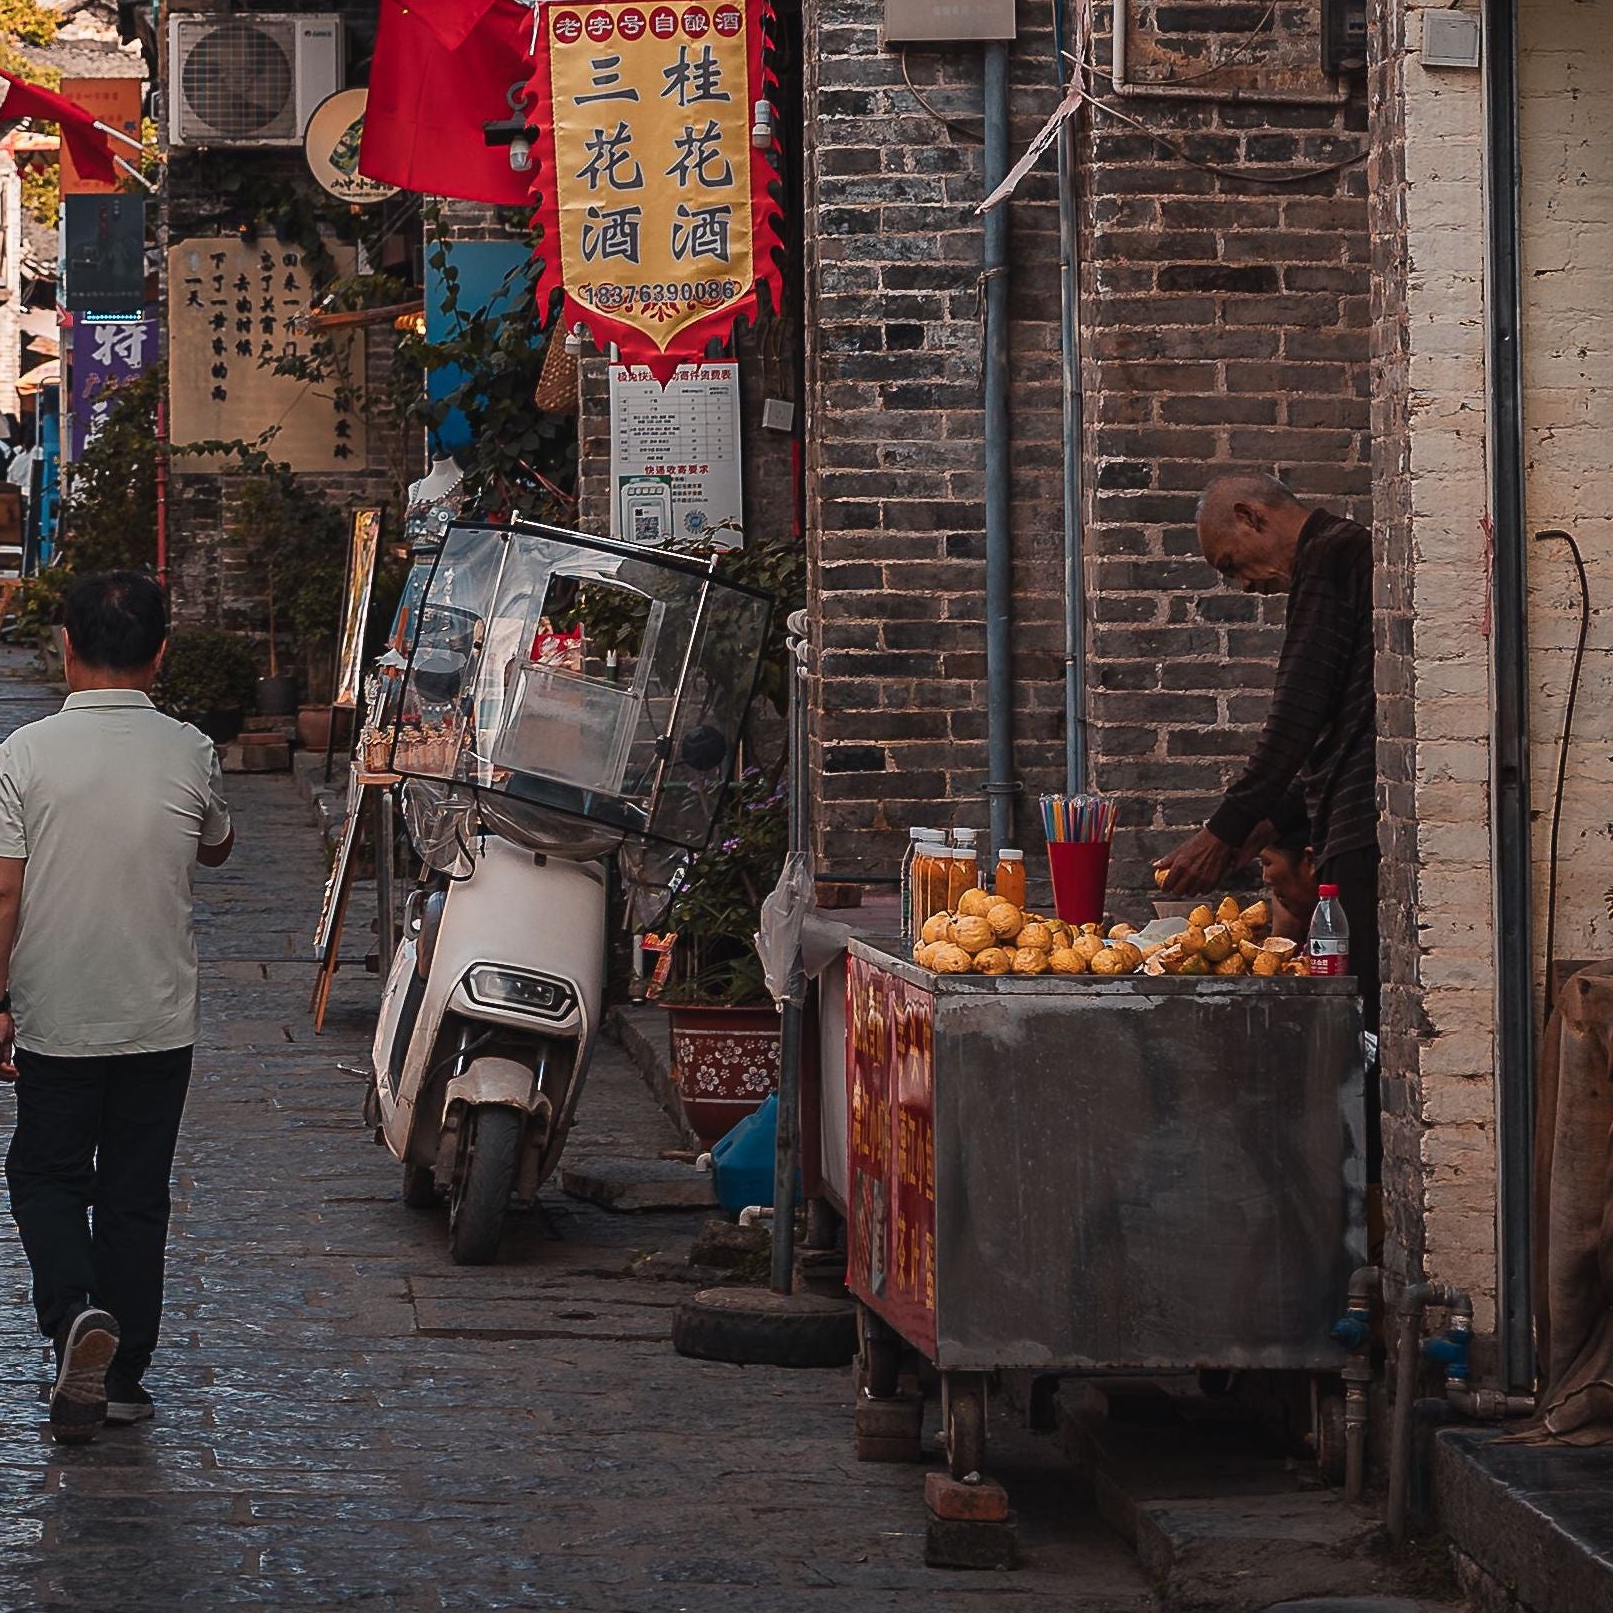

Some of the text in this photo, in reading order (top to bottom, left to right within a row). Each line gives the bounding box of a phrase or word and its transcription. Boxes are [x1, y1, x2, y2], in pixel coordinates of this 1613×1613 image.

[555, 10, 742, 37] 老字号自酿酒
[573, 55, 645, 264] 三花酒
[660, 45, 734, 264] 桂花酒
[584, 279, 735, 306] 18376390086
